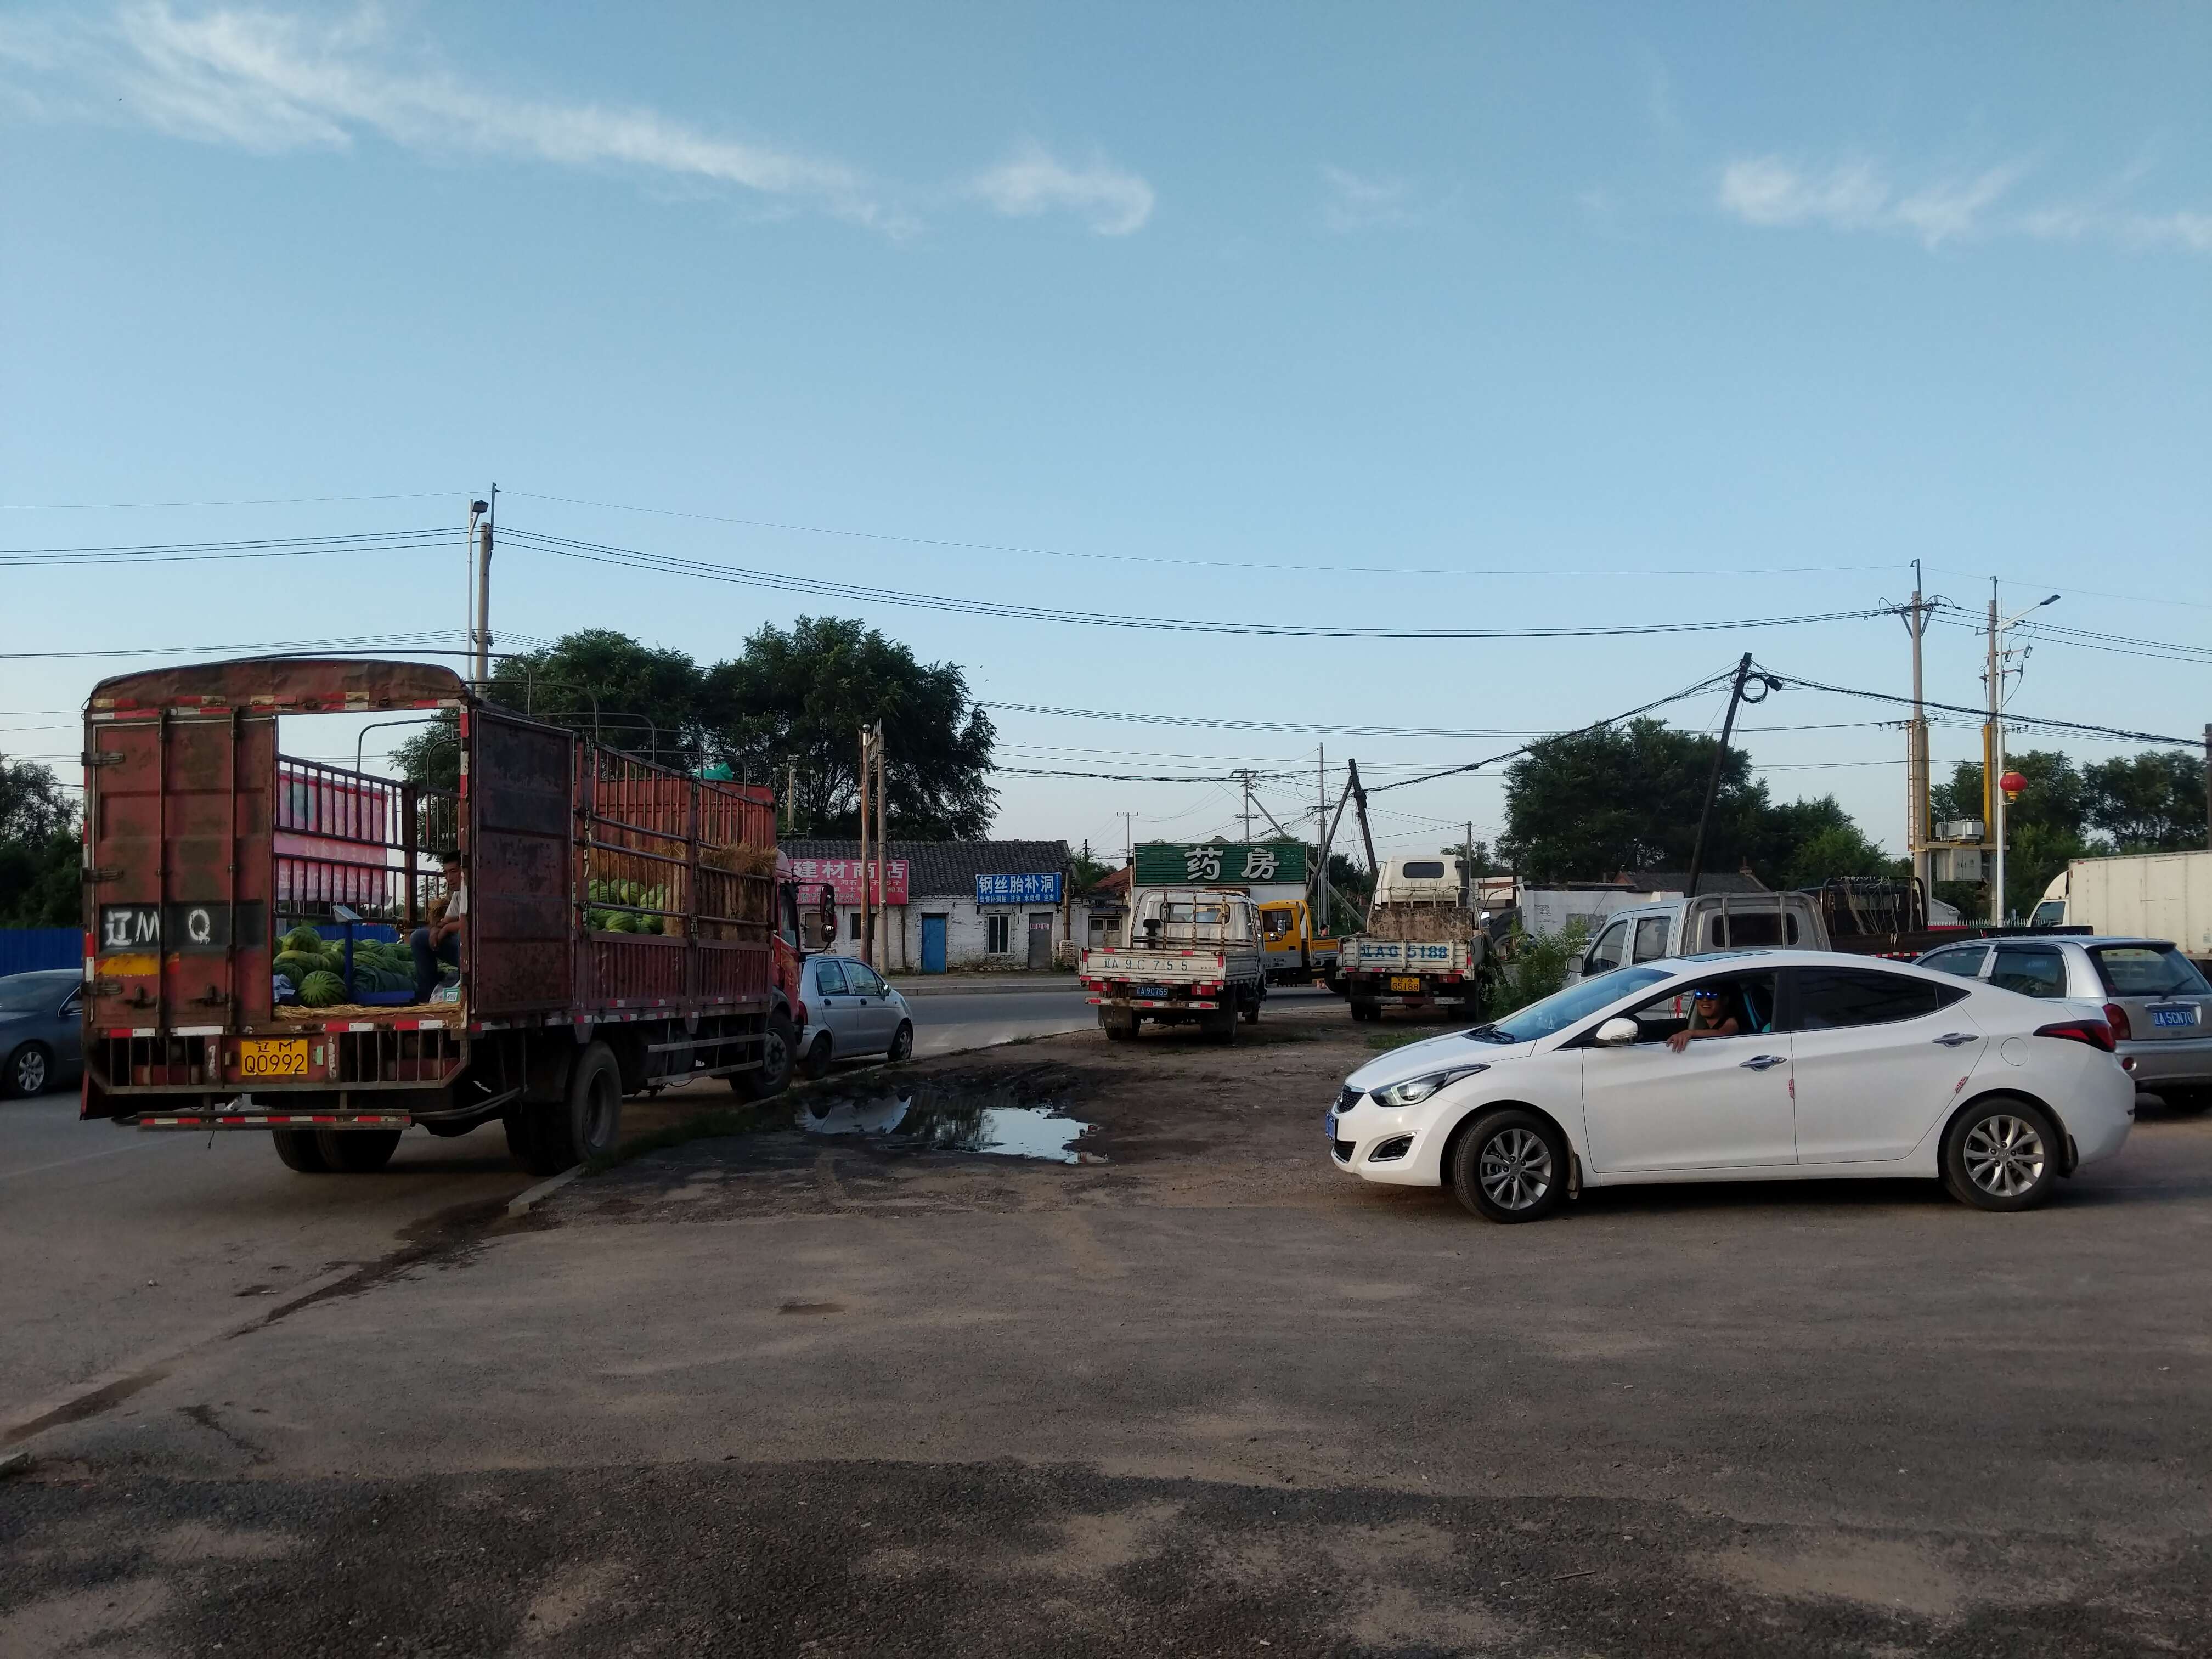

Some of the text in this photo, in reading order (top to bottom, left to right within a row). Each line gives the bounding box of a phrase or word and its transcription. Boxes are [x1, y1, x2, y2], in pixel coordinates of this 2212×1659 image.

[793, 860, 905, 879] 建材商店
[1184, 847, 1280, 880] 药房
[978, 874, 1054, 894] 钢丝胎补洞
[1392, 983, 1418, 991] G5188
[245, 1053, 304, 1073] Q0992
